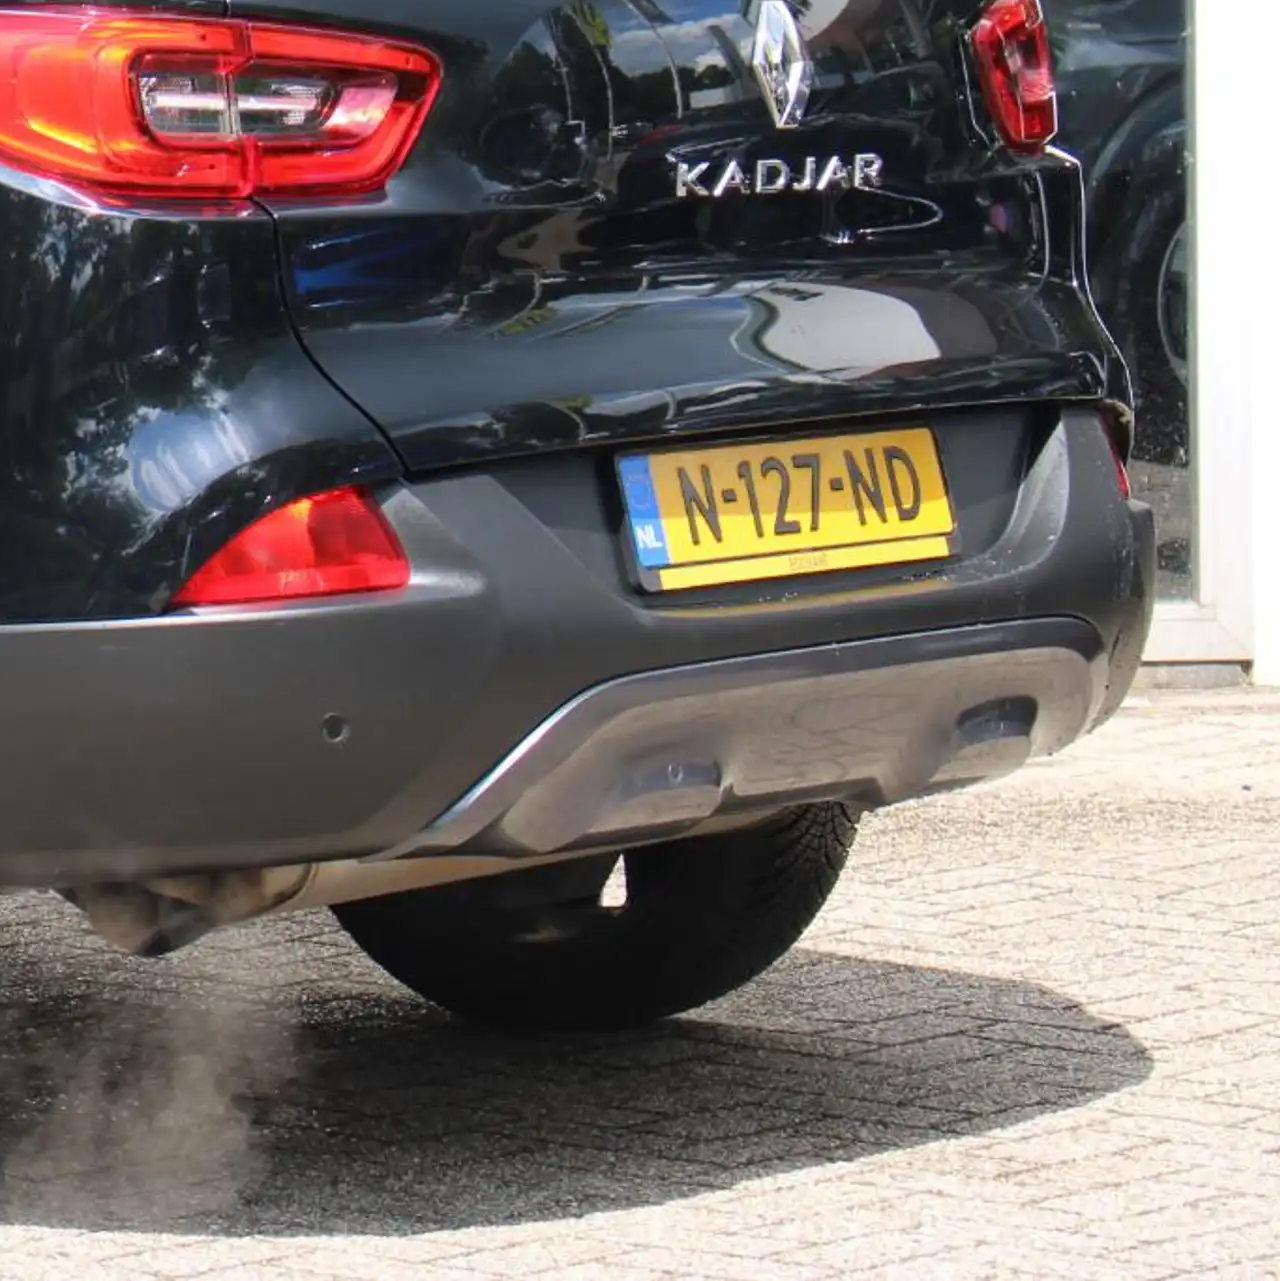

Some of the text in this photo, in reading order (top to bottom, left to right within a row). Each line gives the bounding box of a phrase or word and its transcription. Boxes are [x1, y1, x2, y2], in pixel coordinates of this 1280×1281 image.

[674, 152, 884, 197] KADJAR
[677, 445, 922, 545] N-127-ND
[635, 523, 663, 548] NL
